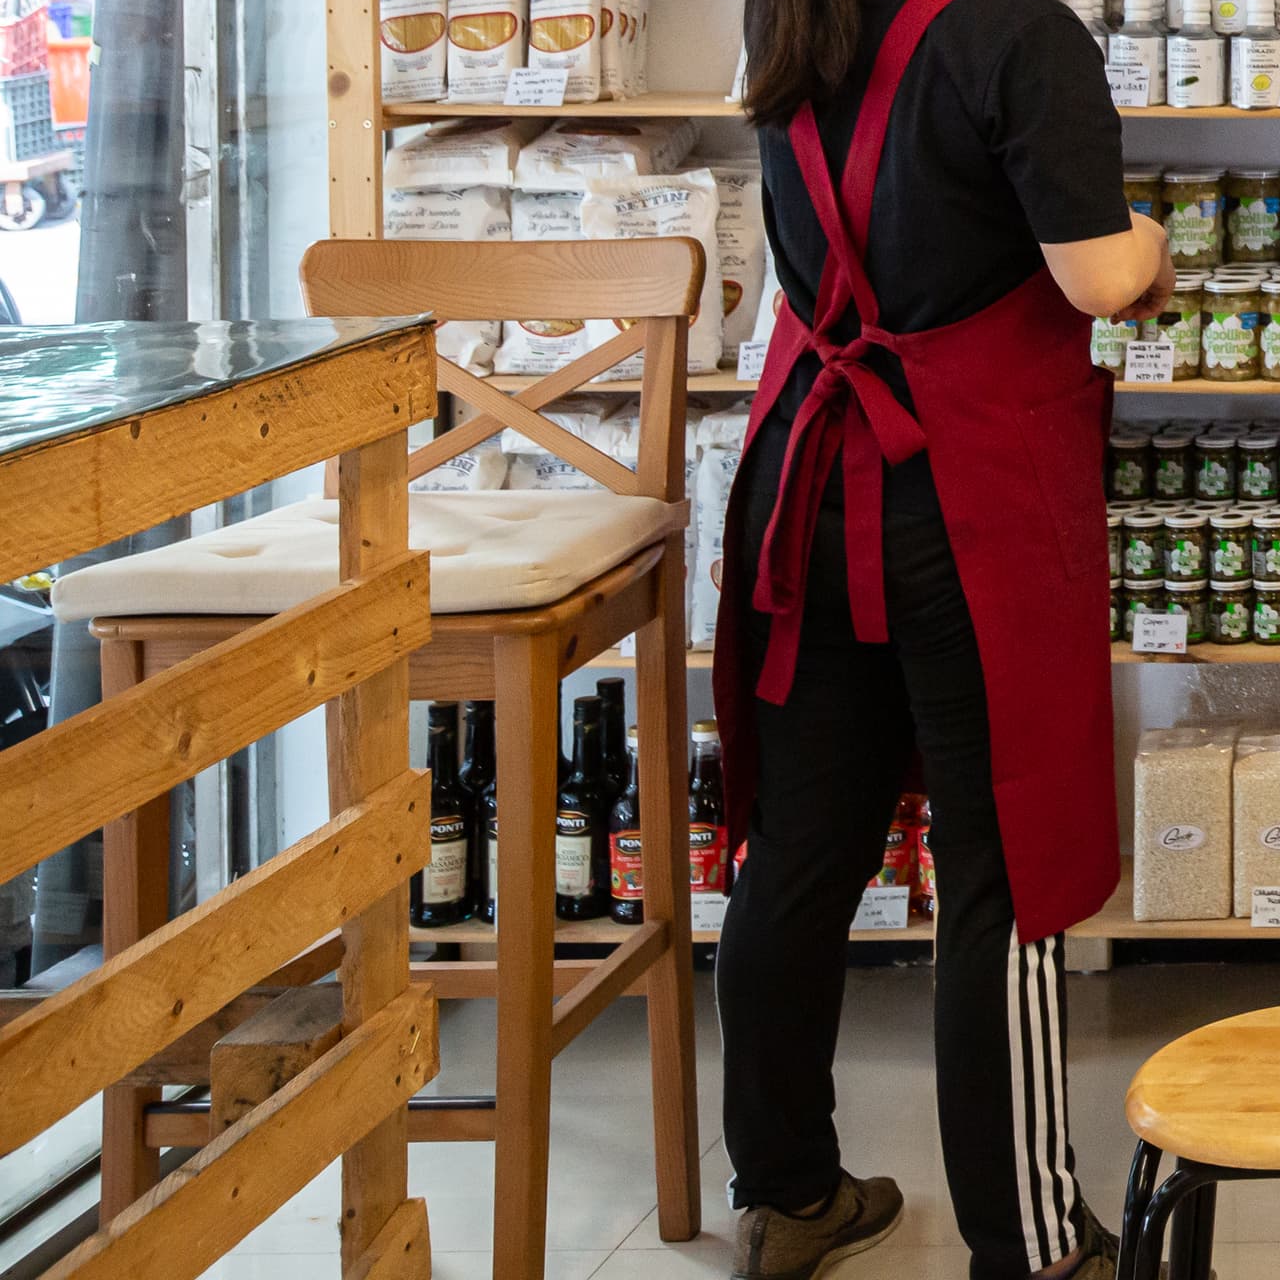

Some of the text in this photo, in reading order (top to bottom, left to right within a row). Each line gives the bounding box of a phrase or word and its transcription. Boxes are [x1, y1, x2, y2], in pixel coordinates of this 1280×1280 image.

[557, 817, 585, 828] PONTI
[431, 823, 464, 834] PONTI
[620, 839, 640, 848] PON
